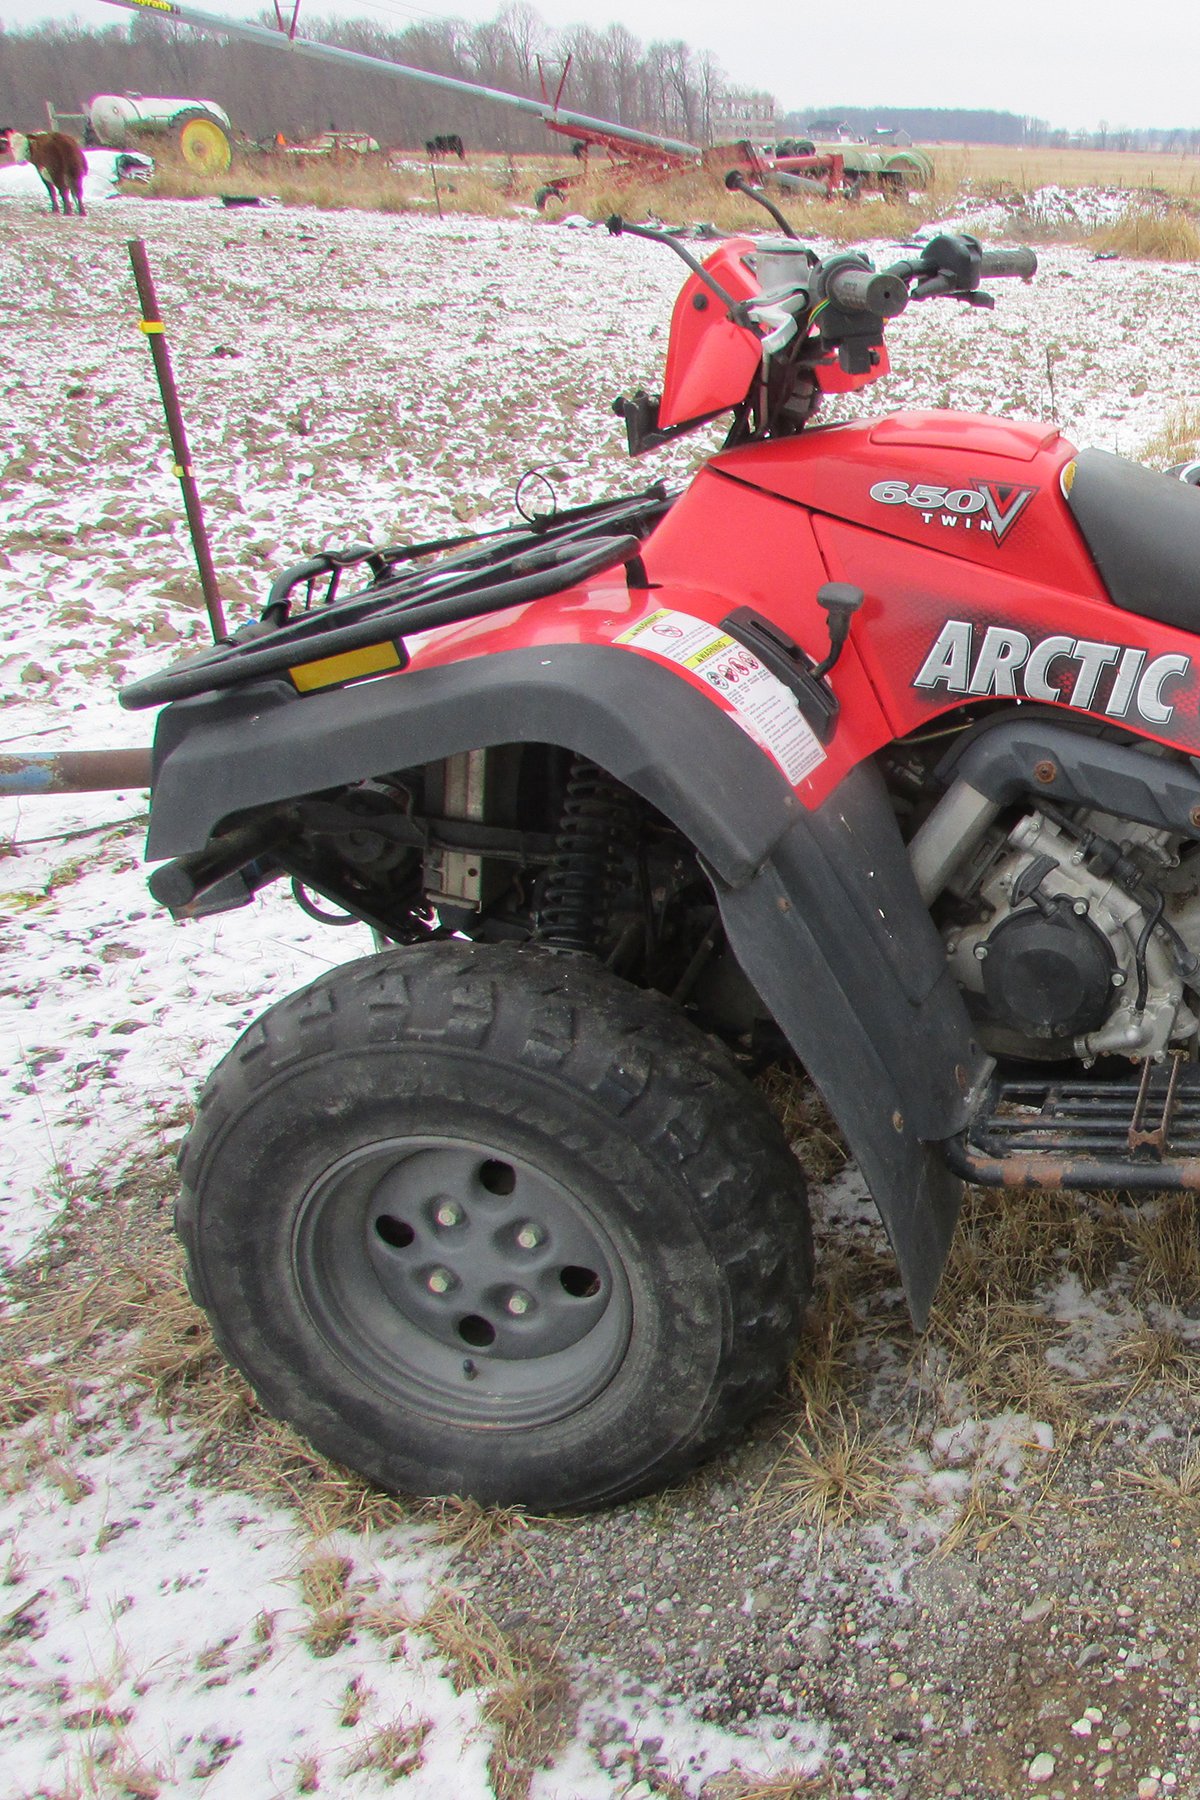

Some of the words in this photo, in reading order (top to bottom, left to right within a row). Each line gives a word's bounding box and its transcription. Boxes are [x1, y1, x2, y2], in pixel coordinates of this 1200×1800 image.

[870, 481, 986, 513] 650
[922, 513, 993, 531] TWIN
[700, 640, 727, 662] WARNING
[913, 619, 1191, 725] ARCTIC
